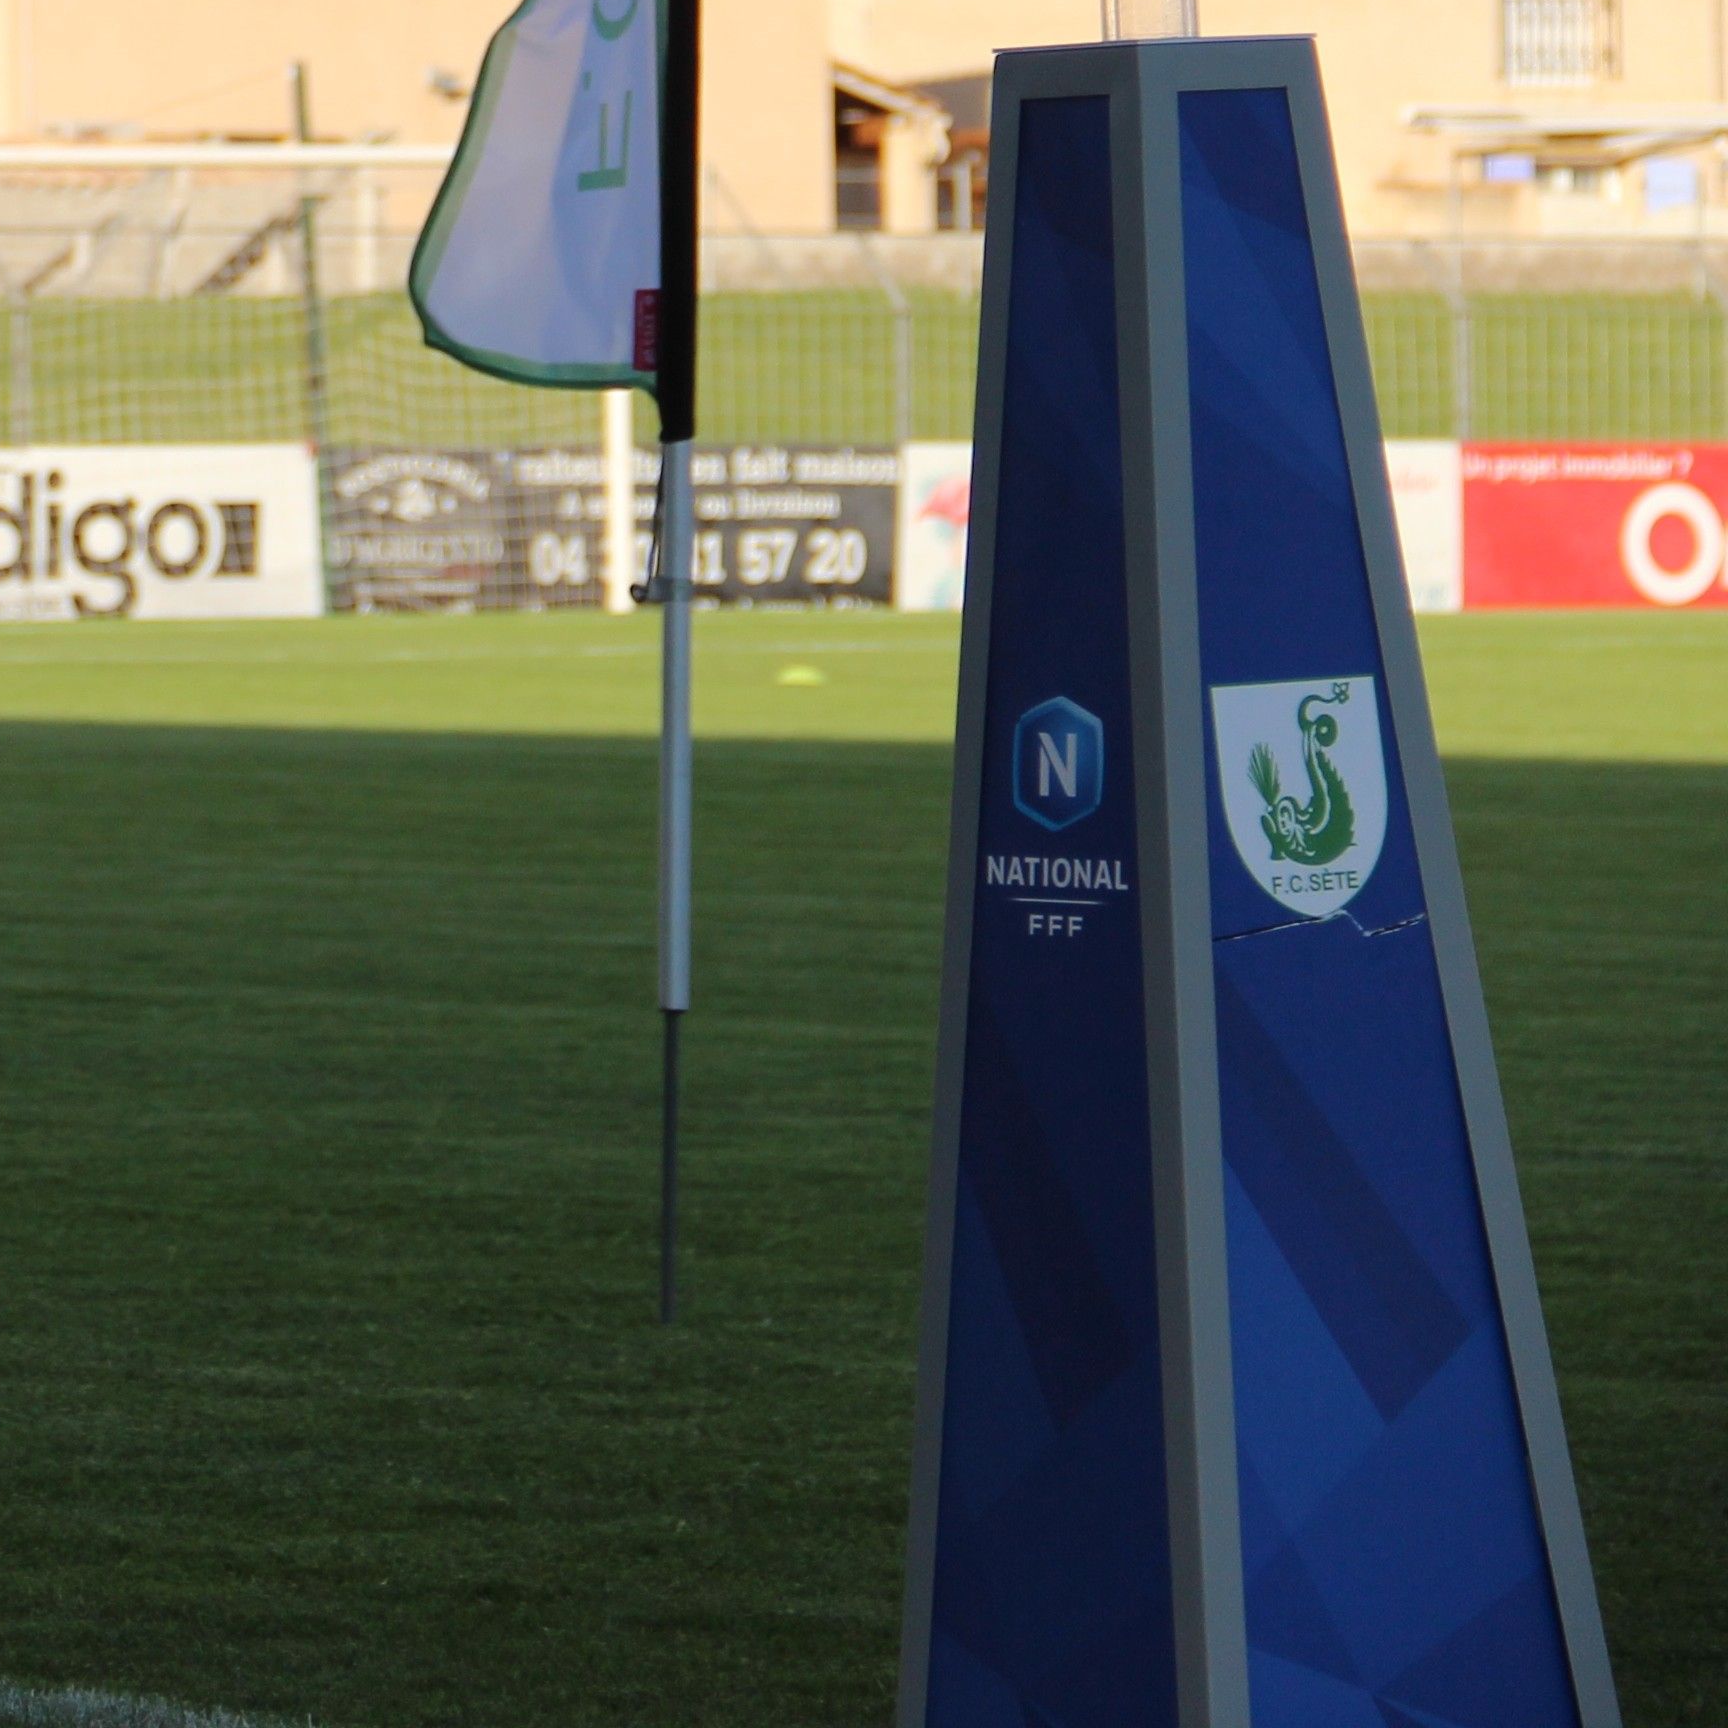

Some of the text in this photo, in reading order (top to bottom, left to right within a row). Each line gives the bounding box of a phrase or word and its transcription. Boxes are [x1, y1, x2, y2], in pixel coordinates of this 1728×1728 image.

[1493, 450, 1559, 485] projet
[531, 533, 587, 586] 04
[737, 528, 799, 586] 57
[803, 527, 868, 586] 20
[1619, 481, 1728, 606] O
[1037, 731, 1079, 798] N
[985, 855, 1130, 891] NATIONAL
[1028, 913, 1085, 937] FFF
